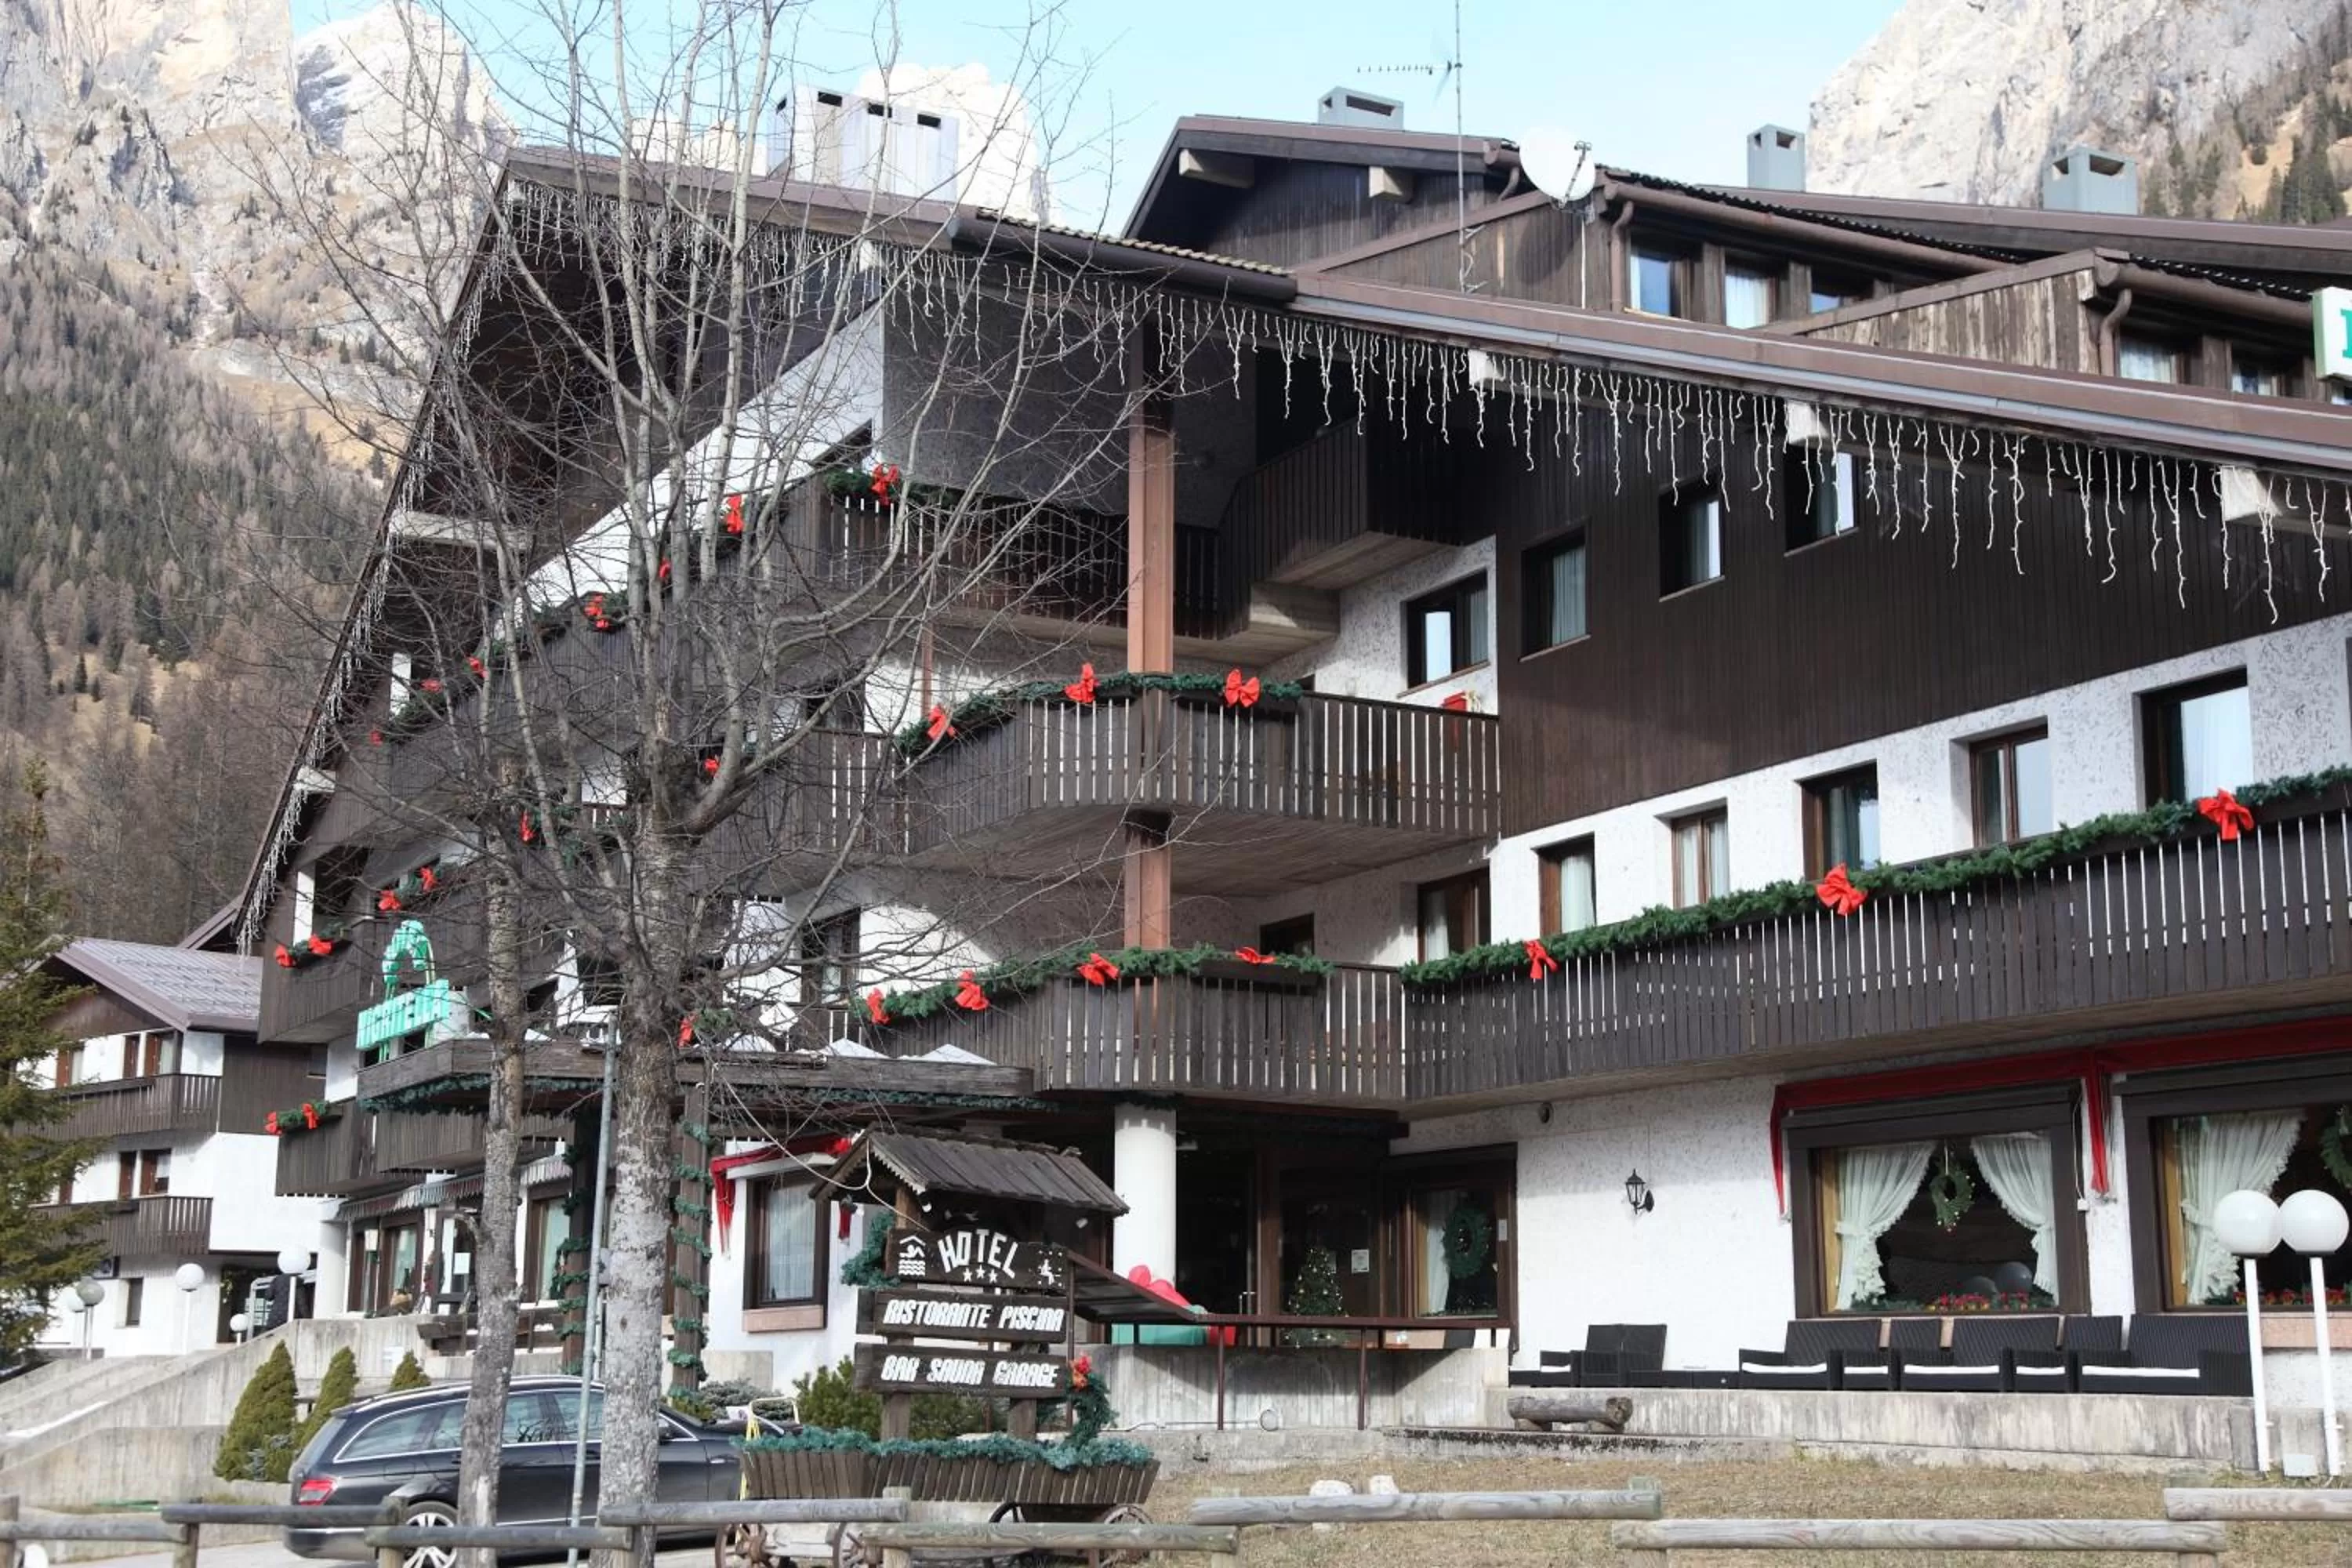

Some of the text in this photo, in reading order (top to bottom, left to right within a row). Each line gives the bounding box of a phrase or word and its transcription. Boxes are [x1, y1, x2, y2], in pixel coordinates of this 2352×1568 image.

[937, 1229, 1018, 1279] HOTEL
[883, 1299, 1065, 1332] RISTORANTE PISCINA
[880, 1355, 1059, 1388] BAR SAUNA GARAGE
